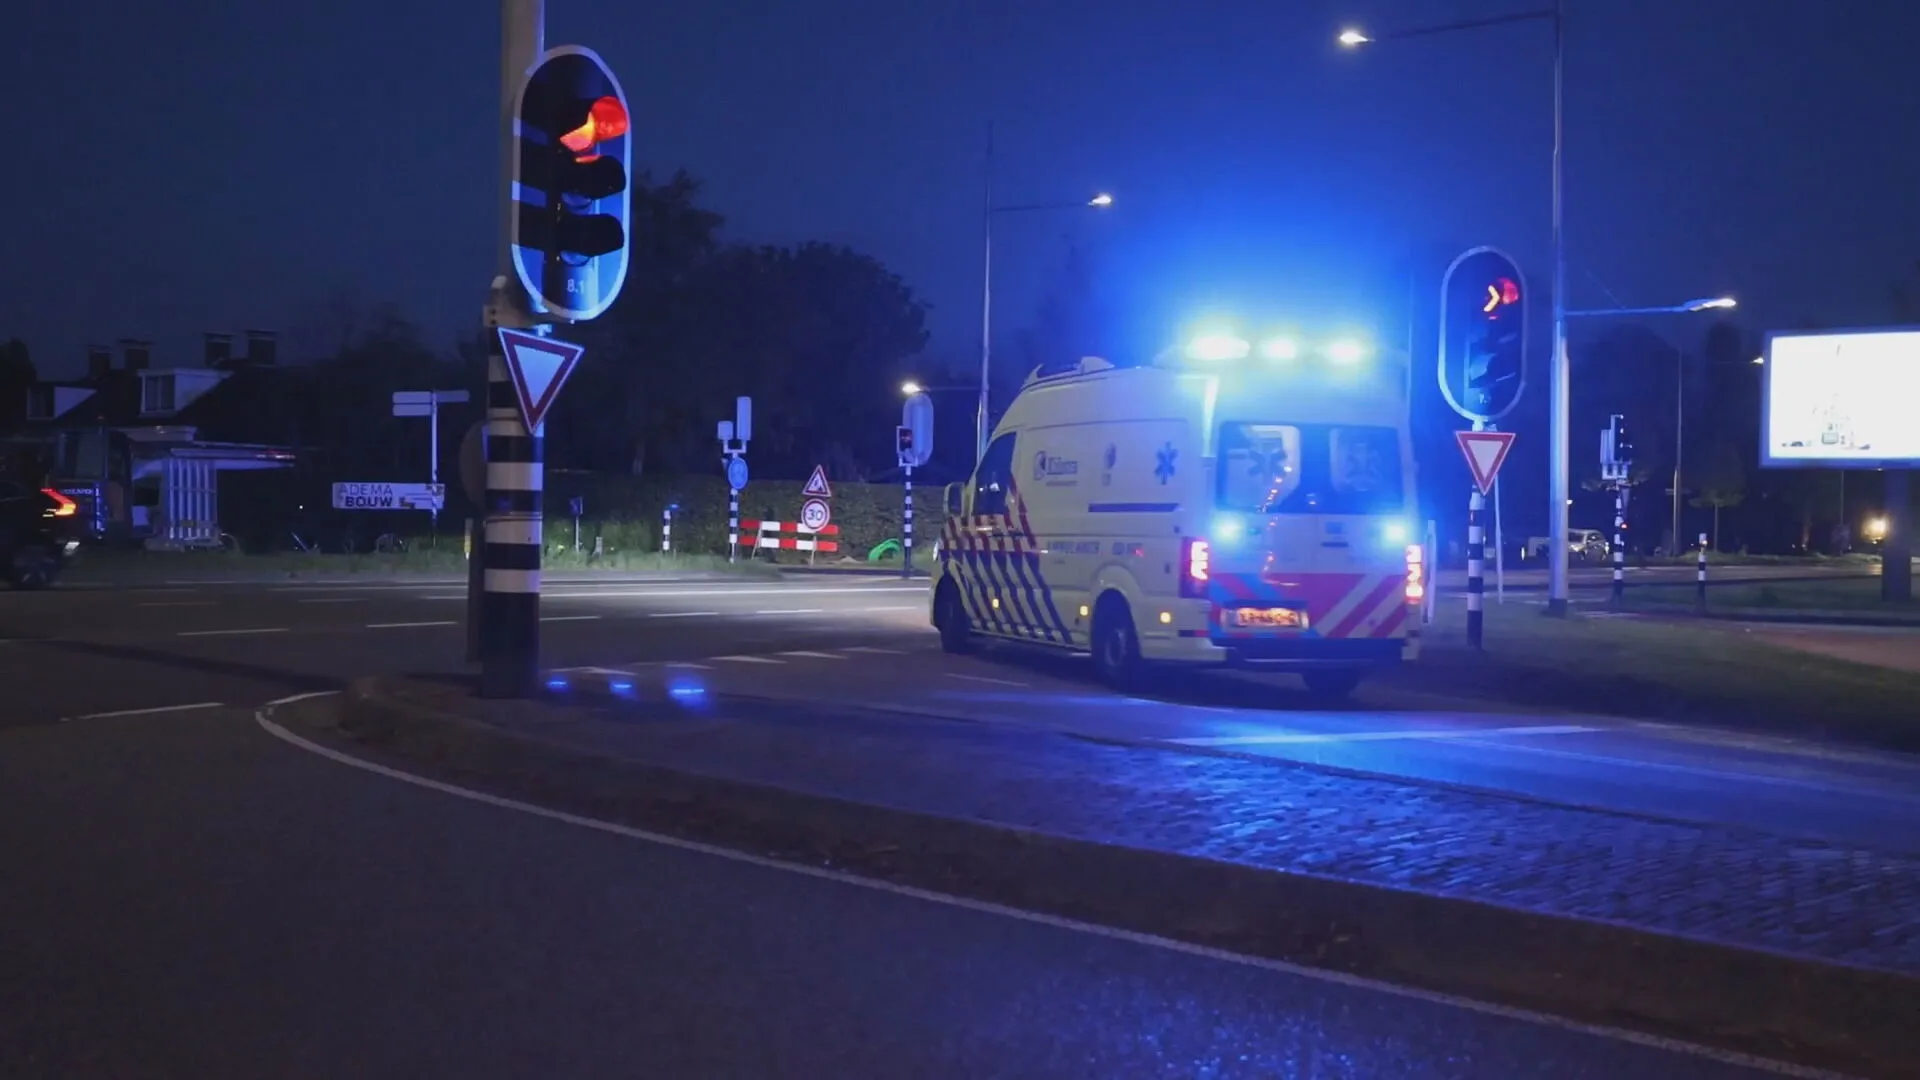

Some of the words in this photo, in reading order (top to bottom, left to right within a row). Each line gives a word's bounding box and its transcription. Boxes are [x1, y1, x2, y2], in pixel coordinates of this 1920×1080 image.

[339, 483, 393, 496] ADEMA
[345, 496, 393, 507] BOUW
[807, 508, 824, 521] 30
